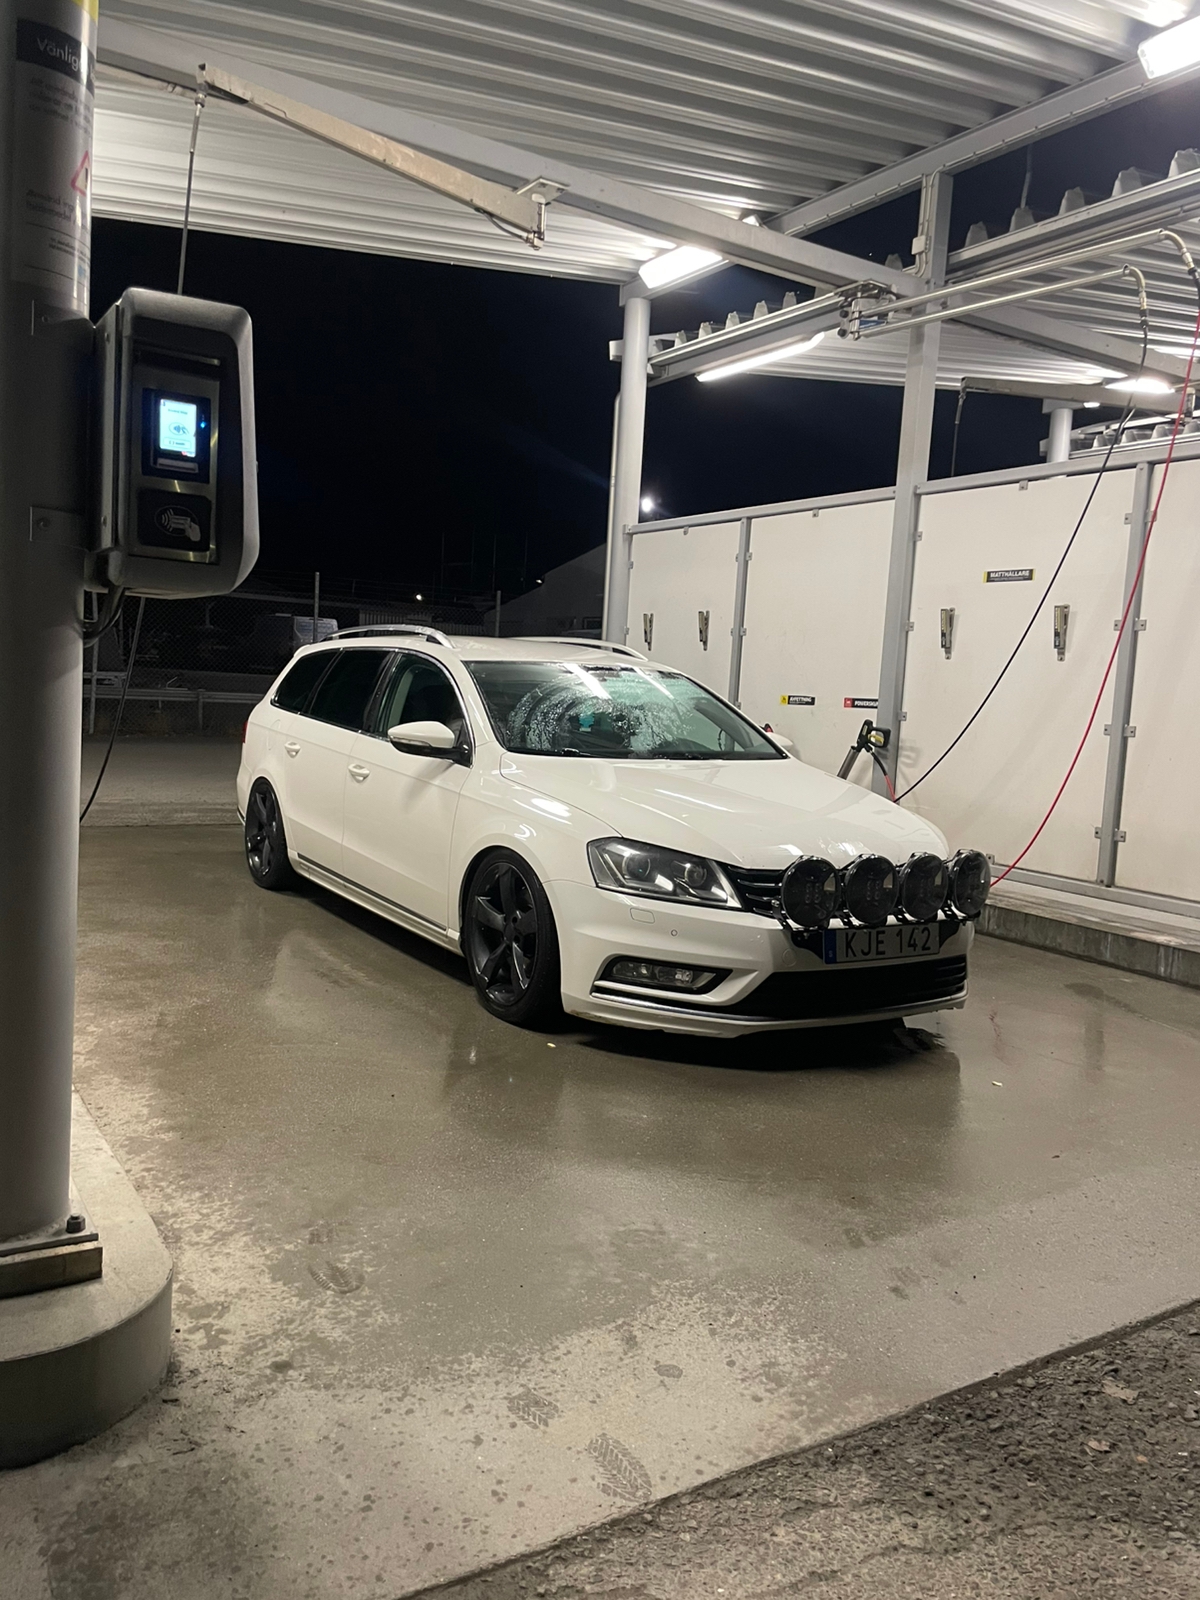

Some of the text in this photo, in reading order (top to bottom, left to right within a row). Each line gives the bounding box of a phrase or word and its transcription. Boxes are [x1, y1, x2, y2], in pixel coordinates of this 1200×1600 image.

[36, 37, 84, 73] Vänlig
[845, 926, 931, 958] KJE 142
